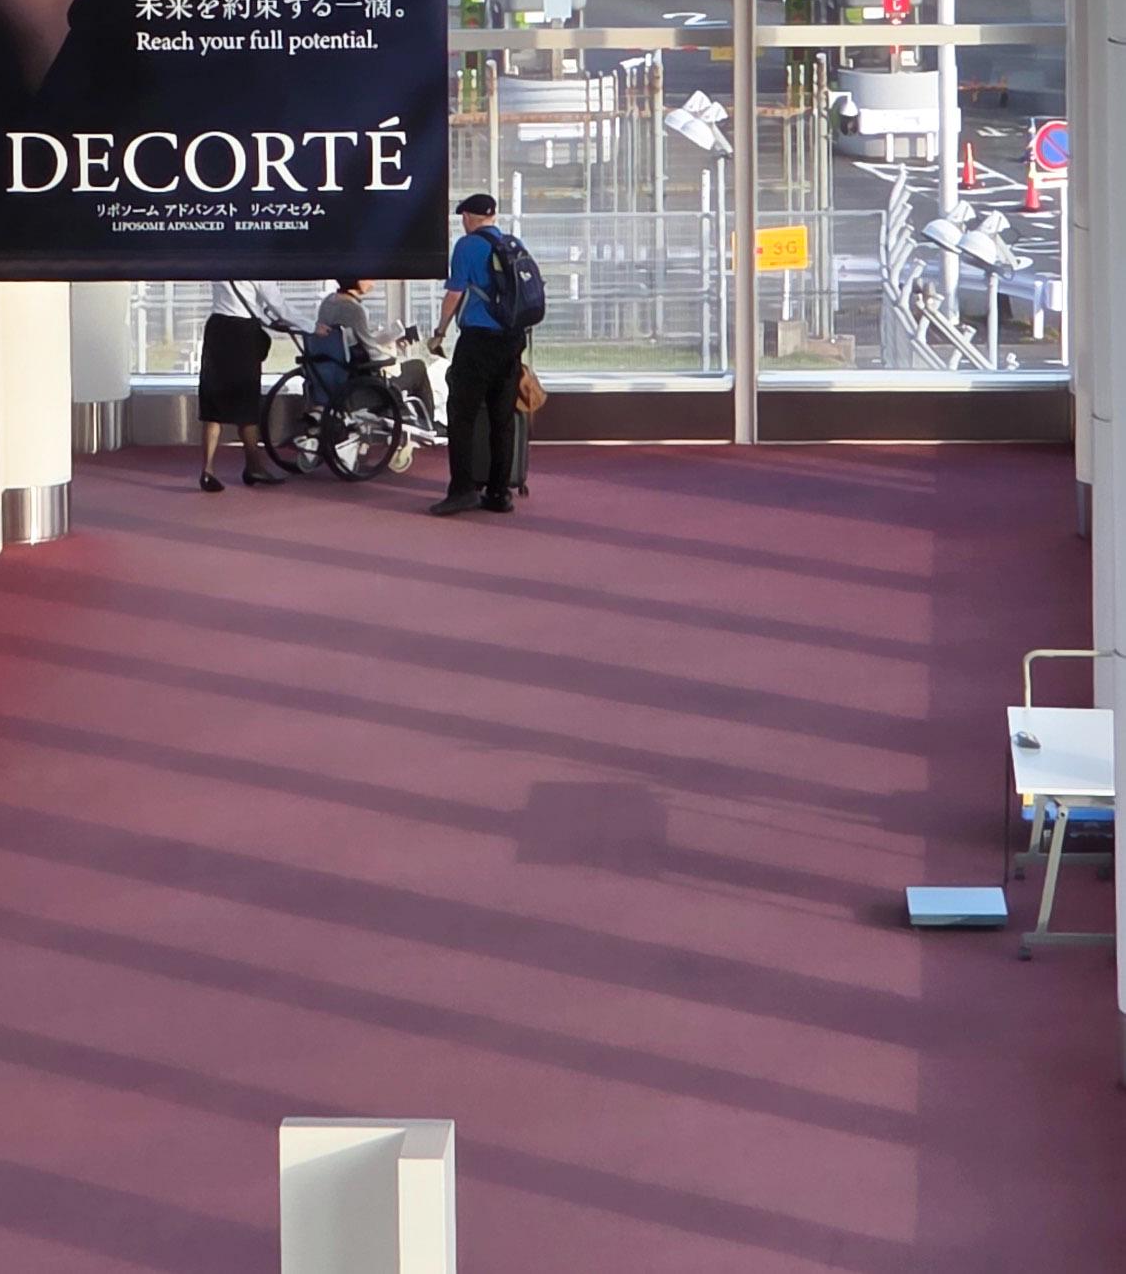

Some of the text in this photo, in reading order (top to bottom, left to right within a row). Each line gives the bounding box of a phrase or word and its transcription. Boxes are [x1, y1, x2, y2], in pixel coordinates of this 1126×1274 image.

[136, 28, 379, 56] Reach your full potential.
[5, 115, 413, 193] DECORTÉ
[96, 202, 326, 218] リポソーム アドバンスト リペアセラム
[112, 220, 309, 232] LIPOSOME ADVANCED REPAIR SERUM
